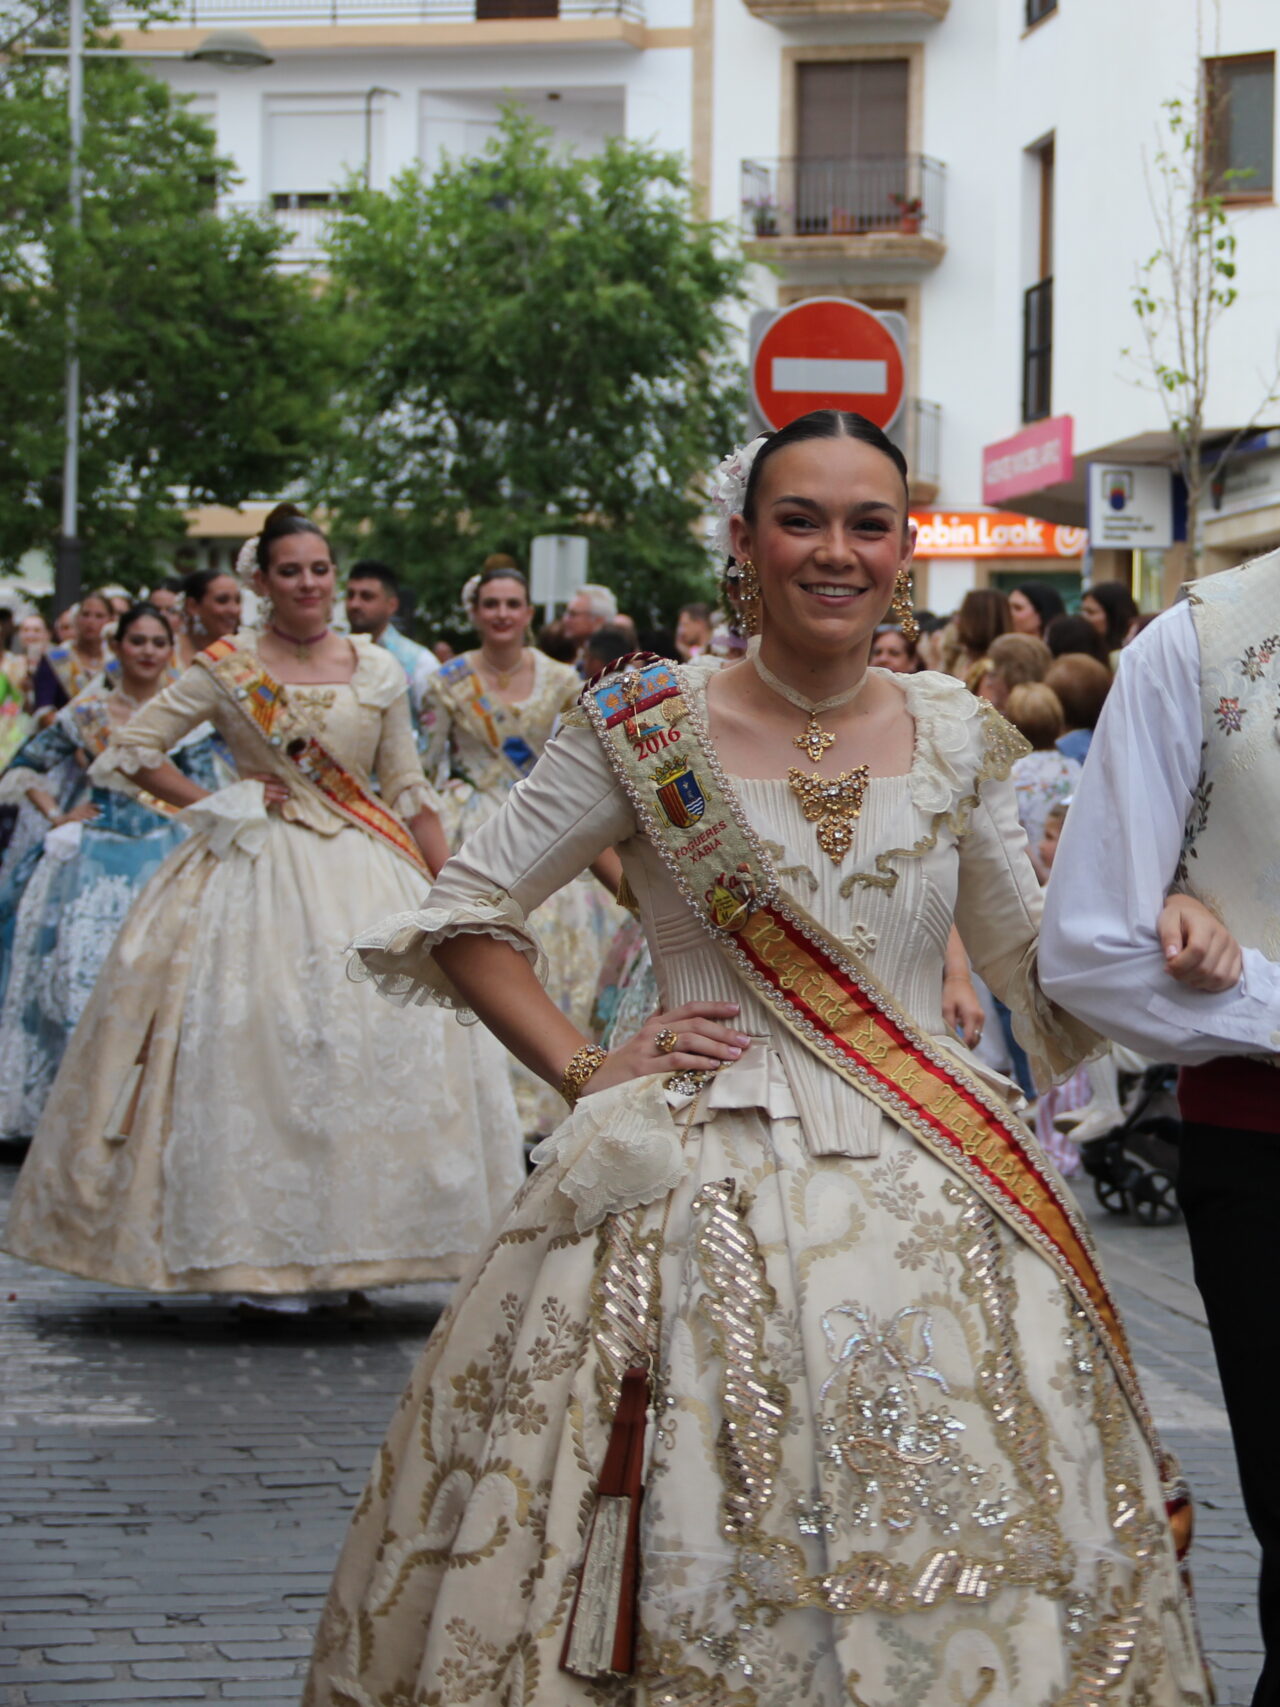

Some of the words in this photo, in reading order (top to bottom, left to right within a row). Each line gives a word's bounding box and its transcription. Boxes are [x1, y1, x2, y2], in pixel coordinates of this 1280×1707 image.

[978, 517, 1044, 545] Look
[632, 724, 681, 761] 2016
[674, 820, 728, 860] FOGUERES
[751, 915, 850, 1027] Regina
[849, 1017, 889, 1065] de
[889, 1053, 922, 1093] la
